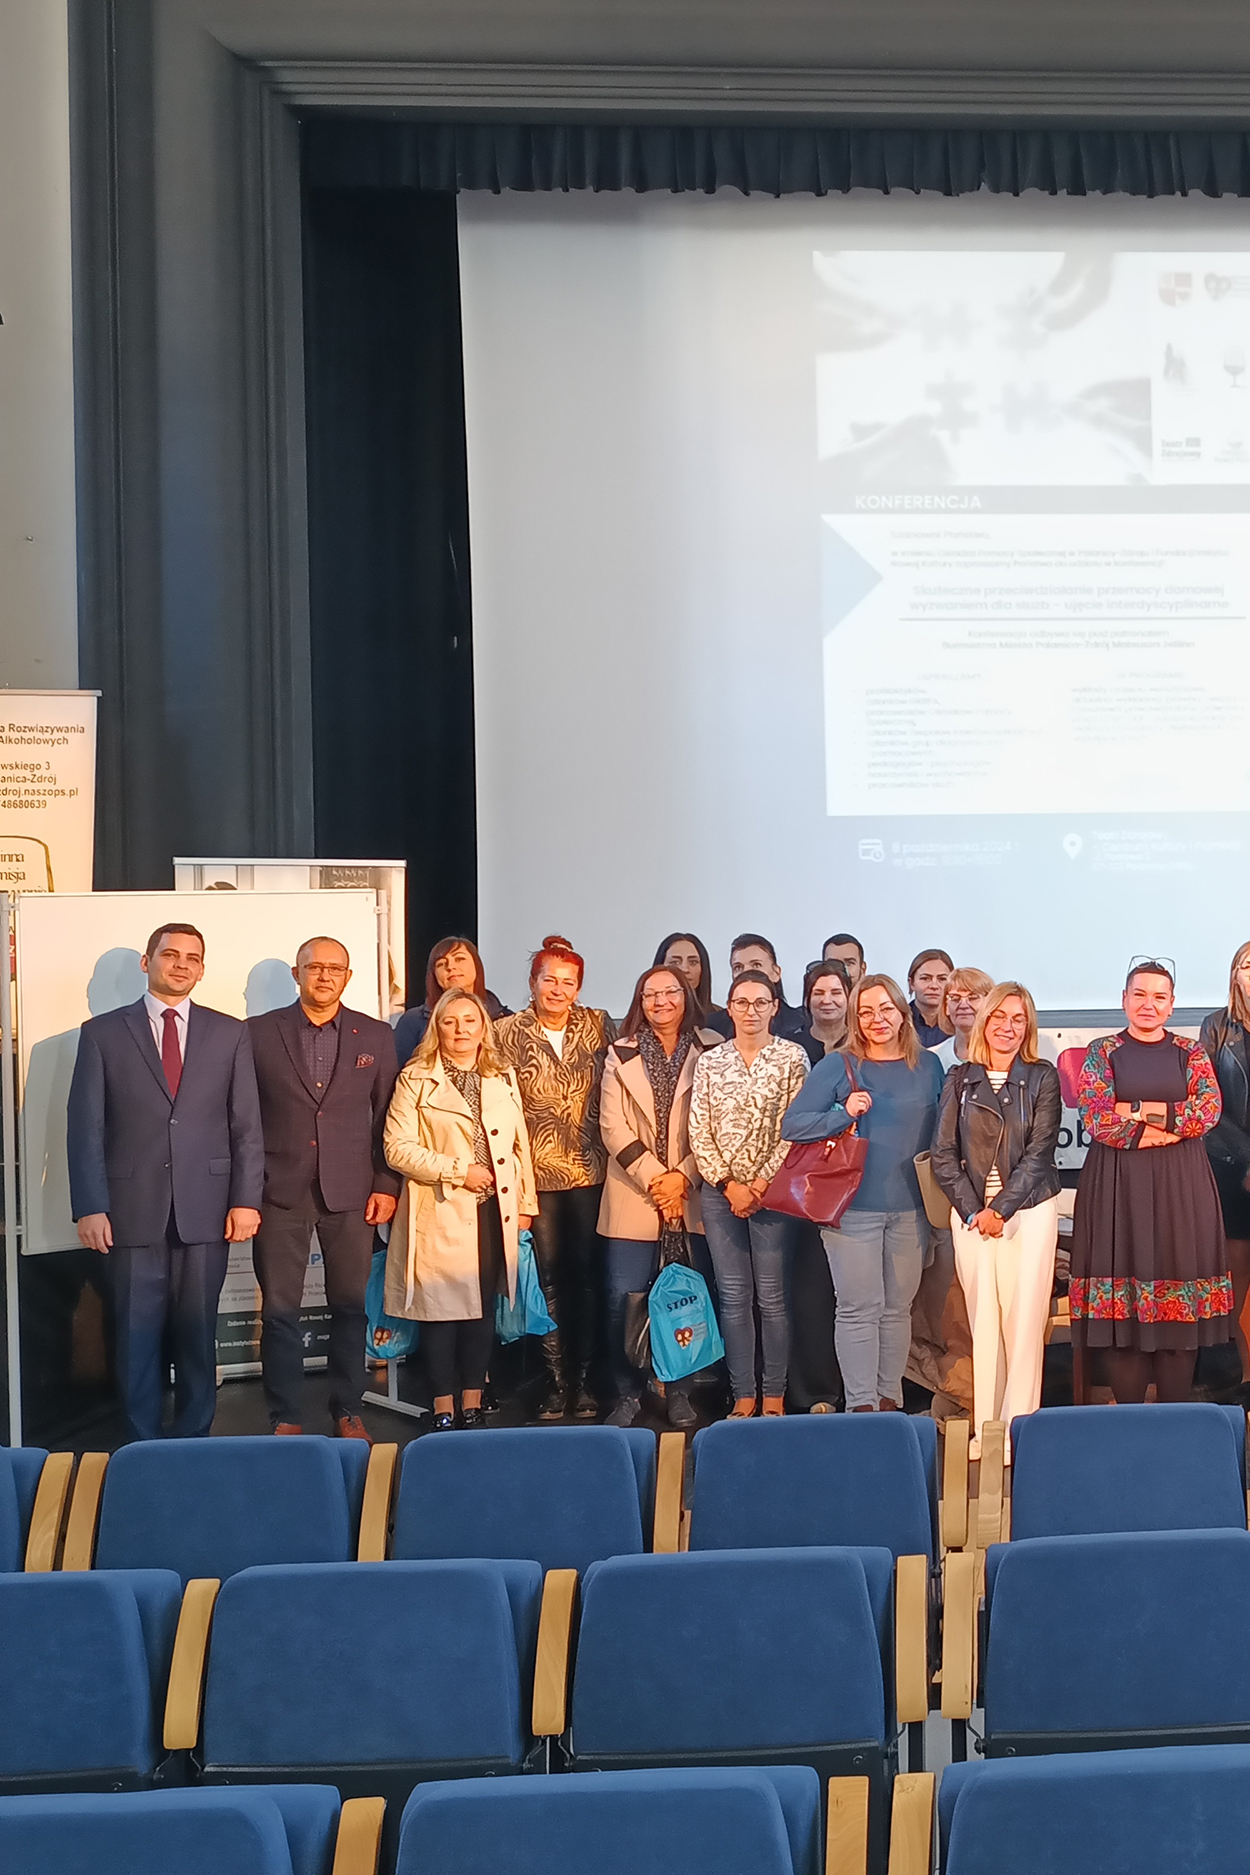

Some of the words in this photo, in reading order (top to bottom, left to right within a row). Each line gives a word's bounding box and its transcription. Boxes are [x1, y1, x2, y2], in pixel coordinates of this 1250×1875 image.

[855, 495, 982, 509] KONFERENCJA
[912, 585, 982, 596] Skuteczne
[983, 584, 1094, 598] przeciwdziałanie
[1097, 585, 1161, 598] przemocy
[1164, 583, 1225, 598] domowej
[908, 600, 989, 612] wyzwaniem
[990, 600, 1013, 611] dla
[1064, 599, 1104, 612] ujęcie
[1106, 599, 1230, 612] interdyscyplinarne
[8, 723, 86, 736] Rozwiązywania
[45, 761, 51, 771] 3
[982, 840, 1012, 852] 2024
[666, 1294, 698, 1313] STOP
